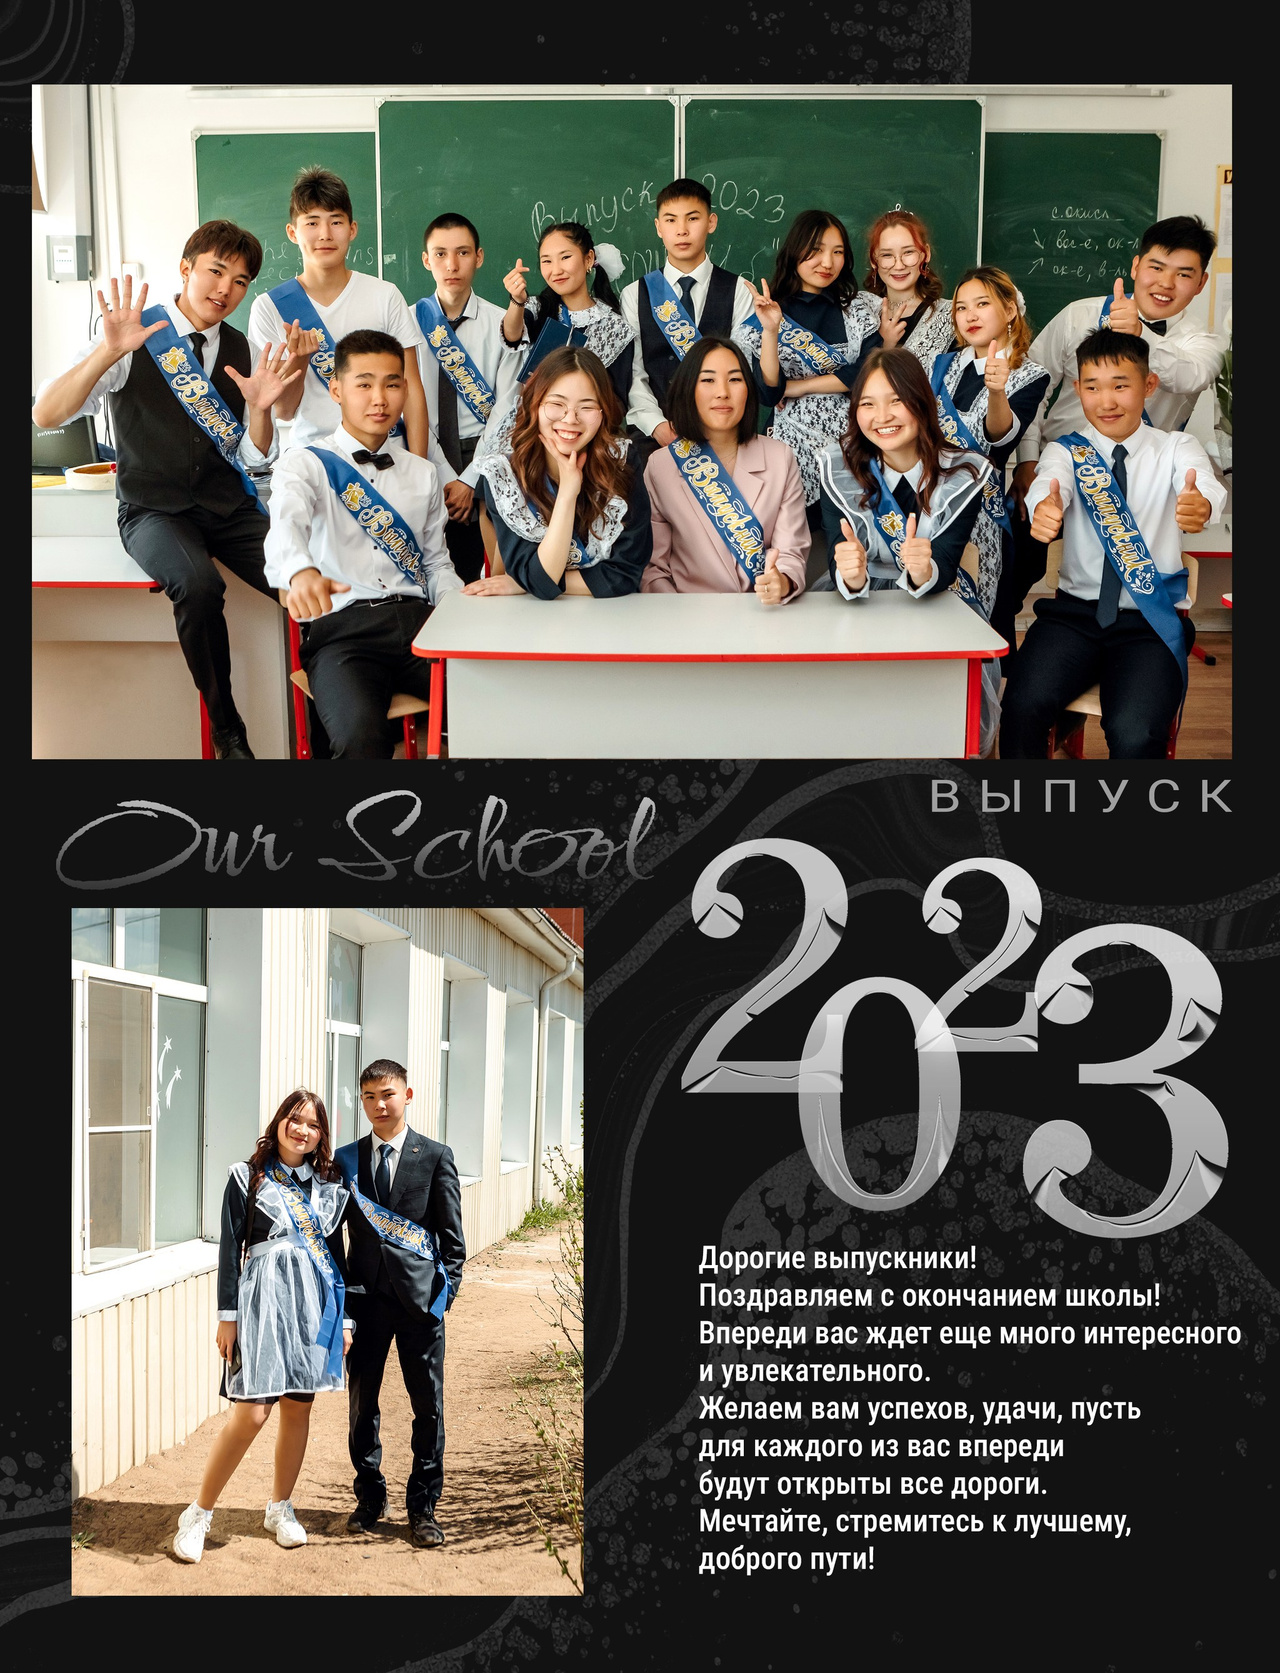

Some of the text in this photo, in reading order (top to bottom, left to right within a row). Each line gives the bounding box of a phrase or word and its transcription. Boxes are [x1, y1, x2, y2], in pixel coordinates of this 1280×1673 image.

[701, 173, 786, 224] 2023
[260, 239, 289, 261] he
[681, 454, 764, 569] Выпускник
[1076, 464, 1153, 583] Выпускник
